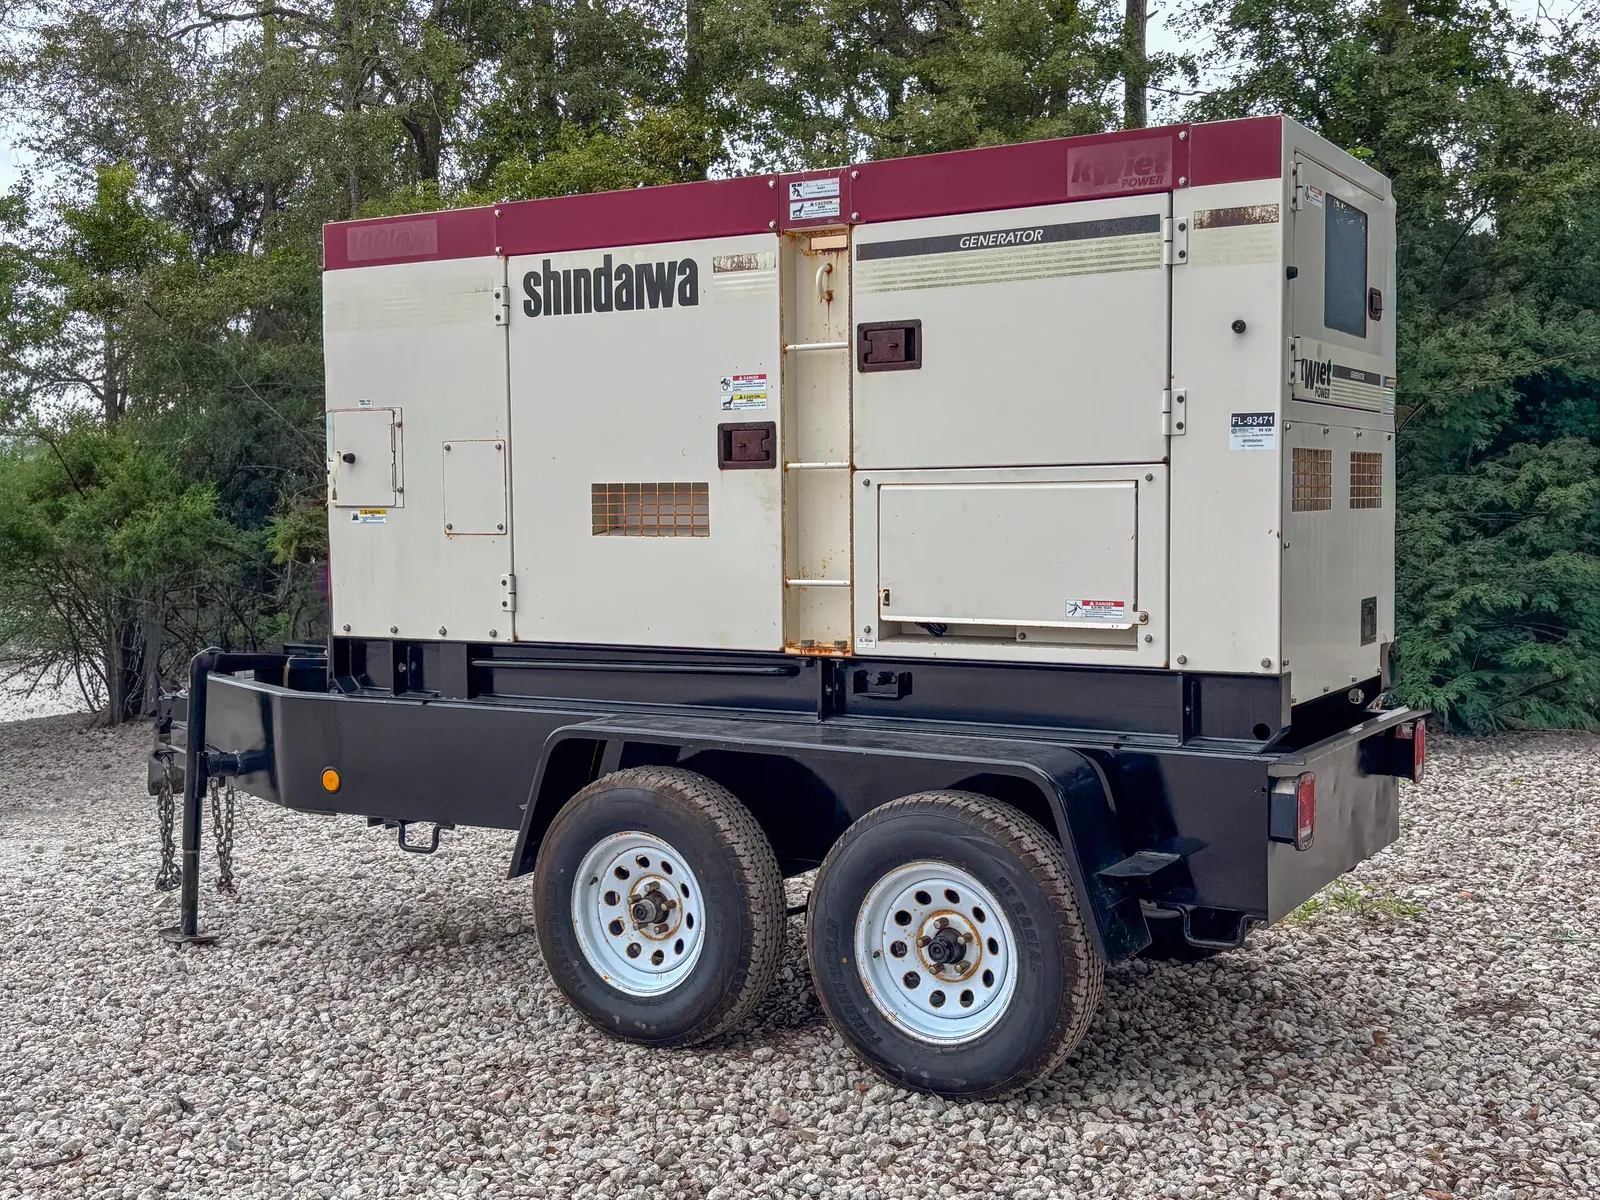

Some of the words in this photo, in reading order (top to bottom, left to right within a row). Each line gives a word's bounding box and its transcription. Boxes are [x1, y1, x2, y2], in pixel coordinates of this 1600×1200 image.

[1121, 175, 1164, 188] POWER
[960, 229, 1043, 249] GENERATOR
[522, 253, 699, 318] shindaiwa
[1315, 387, 1330, 399] POWER
[1232, 416, 1273, 426] FL-93471
[1011, 901, 1042, 972] RADIAL
